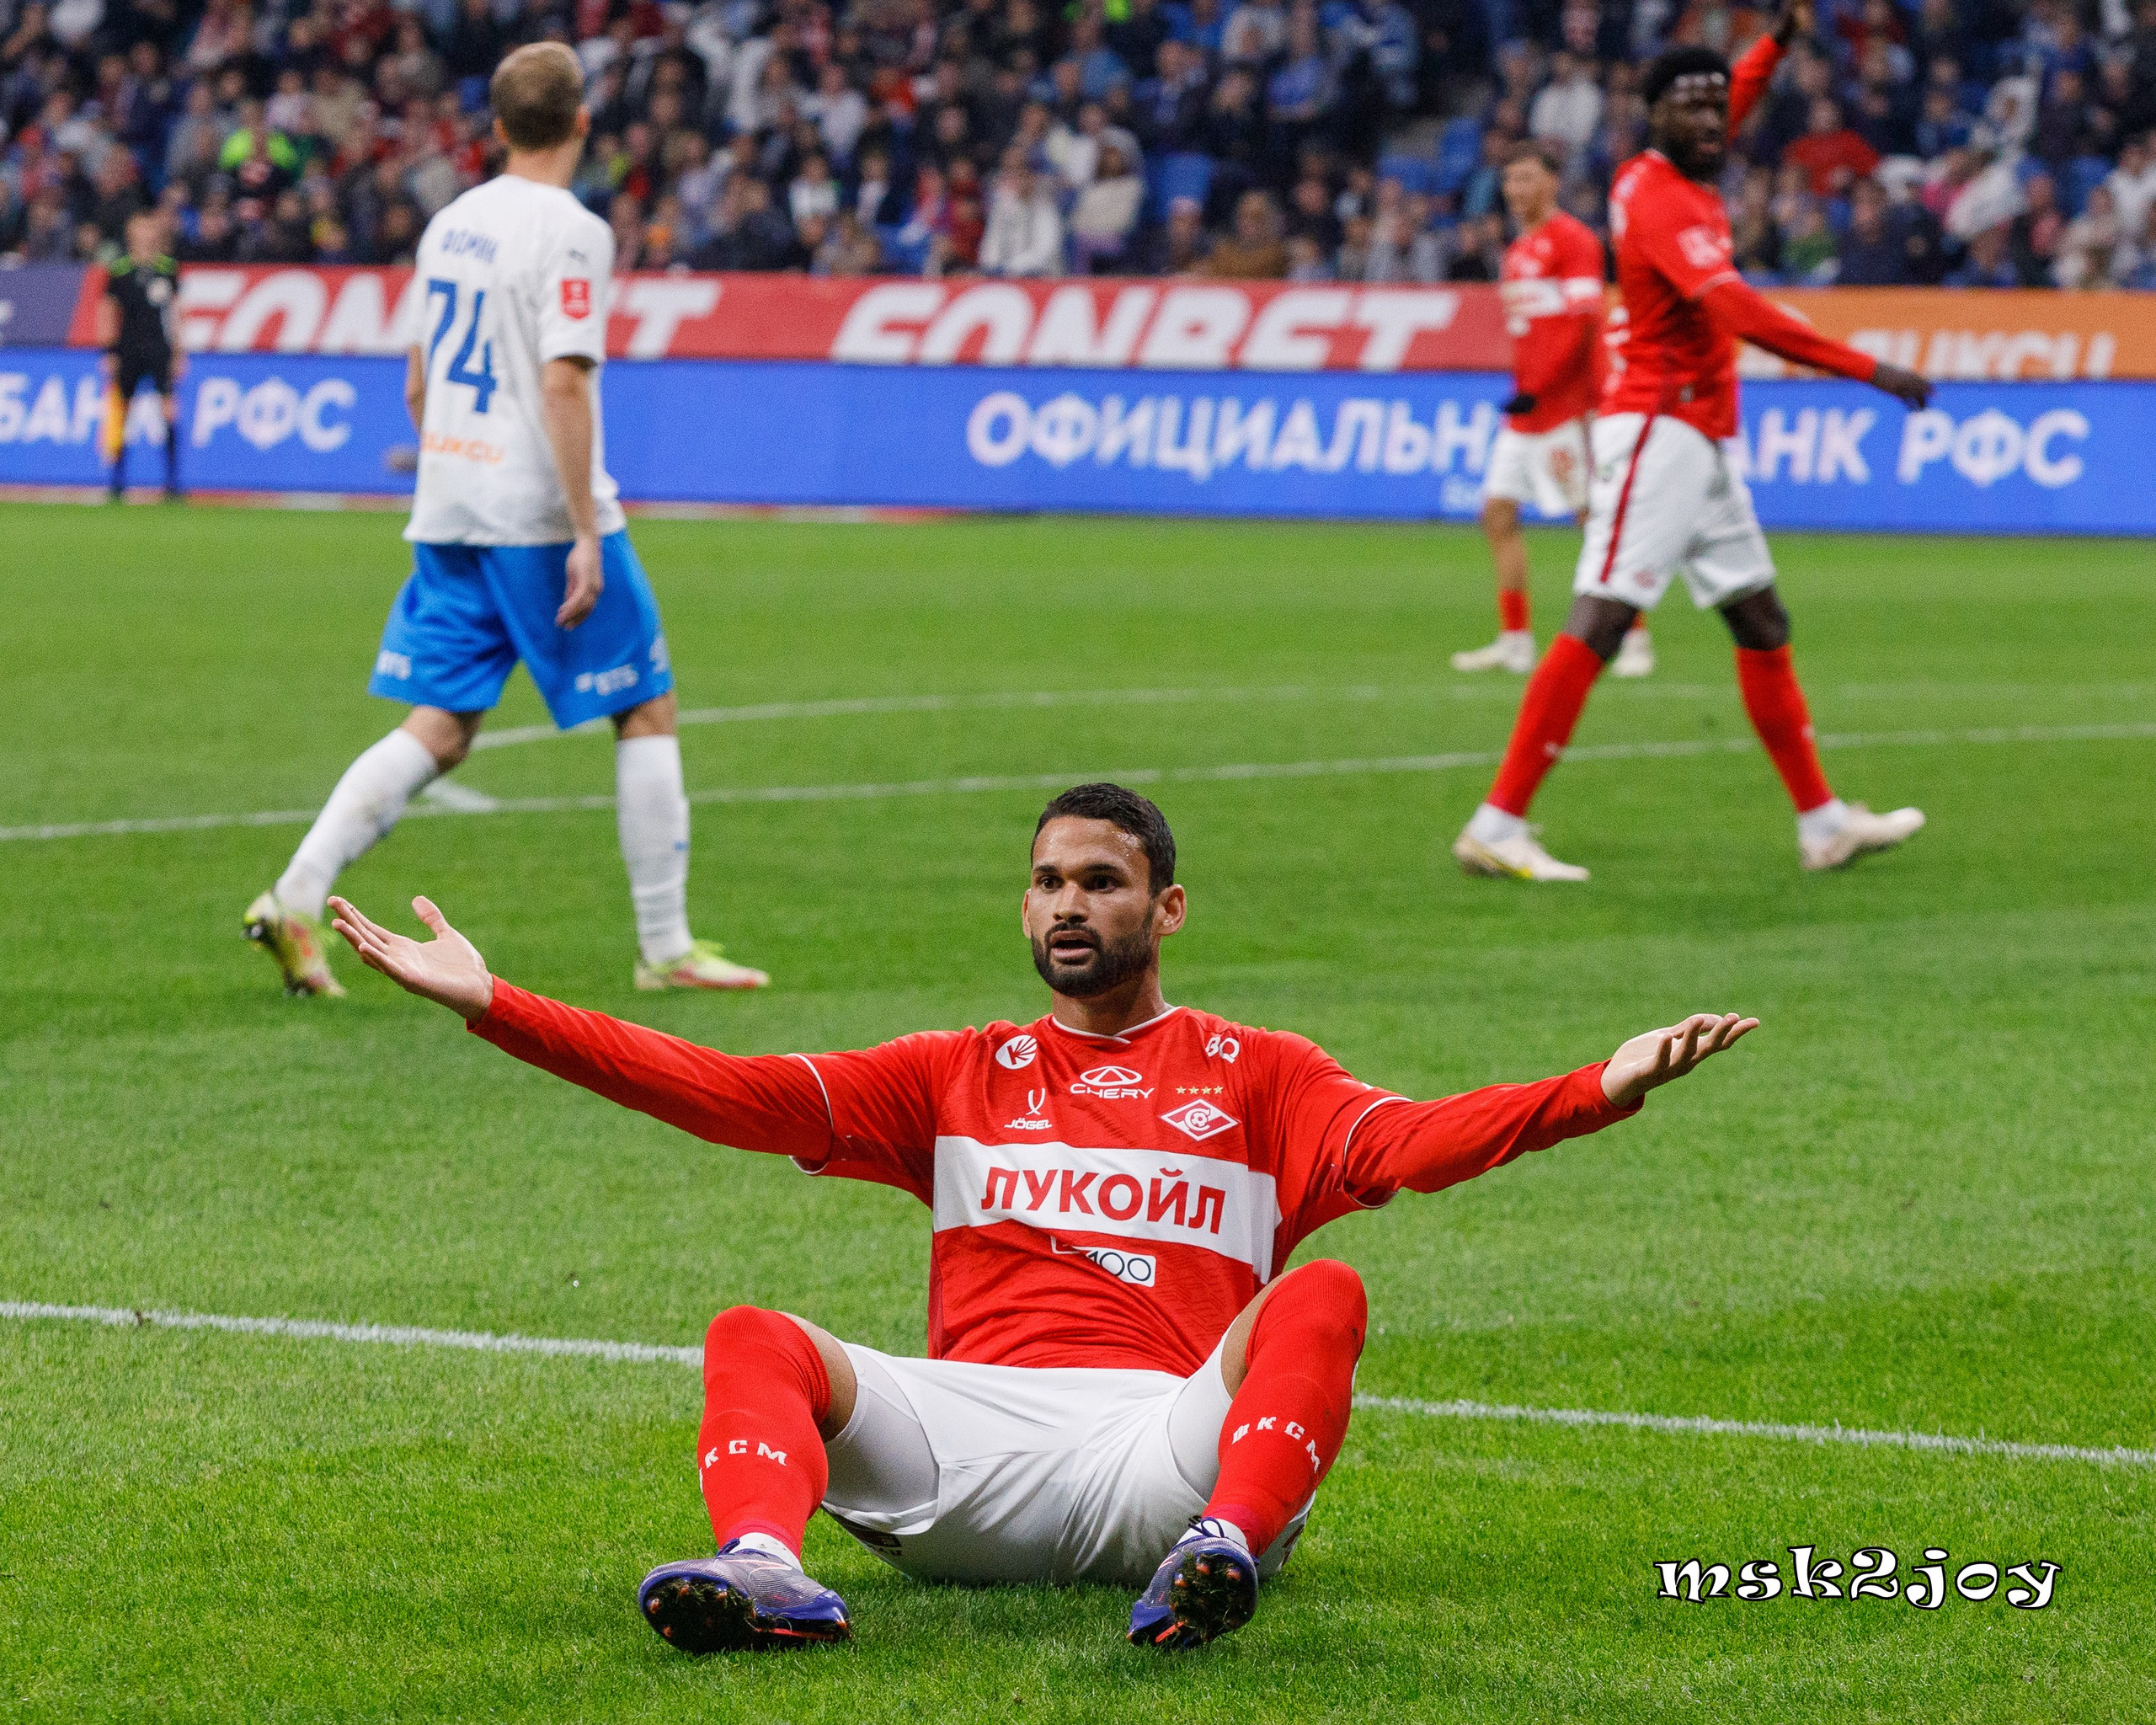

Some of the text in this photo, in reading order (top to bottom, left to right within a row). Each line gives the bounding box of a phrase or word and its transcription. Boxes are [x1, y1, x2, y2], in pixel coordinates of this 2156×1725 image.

[427, 277, 497, 414] 74
[828, 281, 1461, 371] FONBET
[192, 376, 357, 451] РФС
[967, 391, 1500, 484] ОФИЦИАЛЬН
[1897, 407, 2089, 489] РФС
[1070, 1083, 1155, 1099] CHERY
[981, 1166, 1226, 1235] ЛУКОЙЛ
